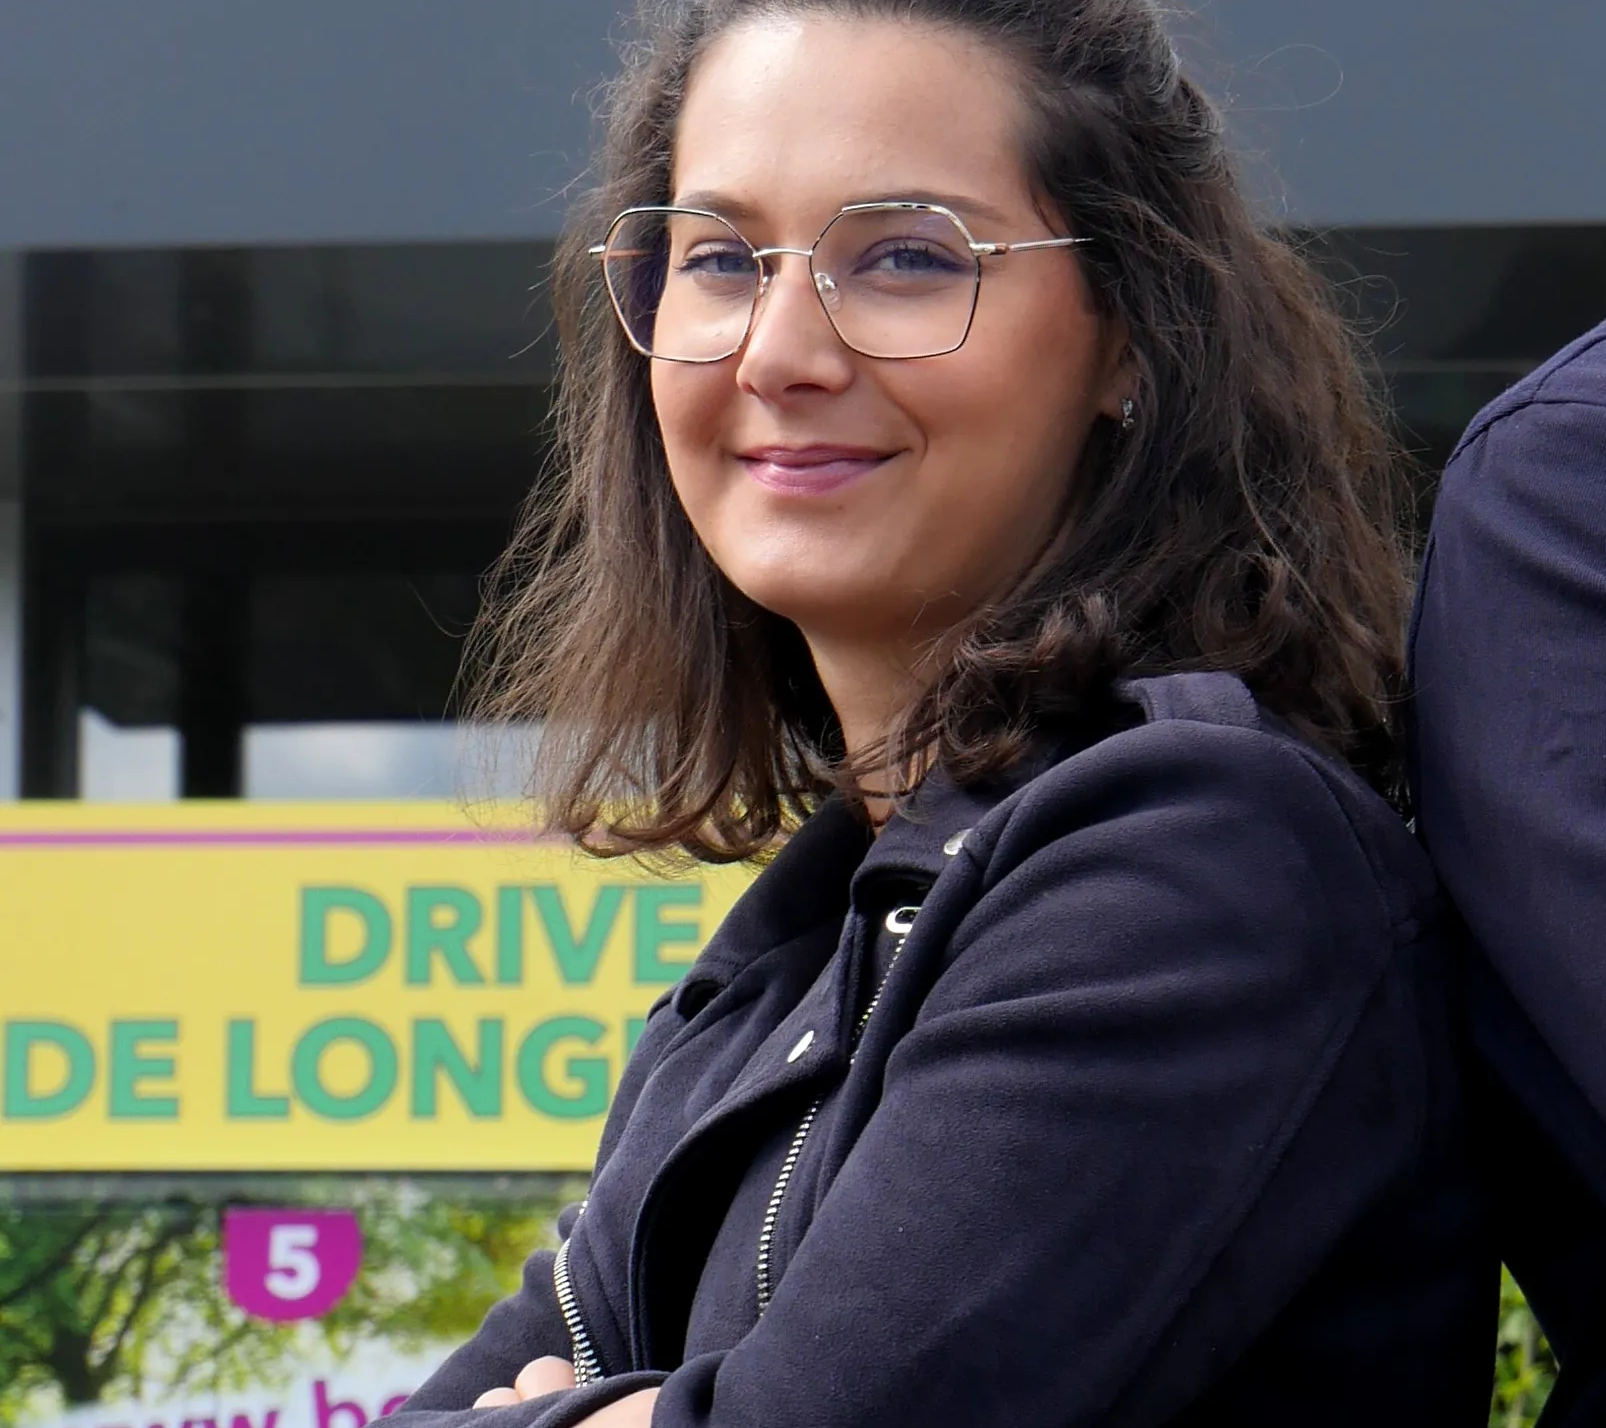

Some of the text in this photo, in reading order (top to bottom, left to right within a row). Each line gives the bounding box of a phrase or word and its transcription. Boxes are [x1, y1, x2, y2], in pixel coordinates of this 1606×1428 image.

[298, 885, 702, 985] DRIVE
[2, 1016, 646, 1120] DE LONG
[265, 1224, 320, 1300] 5
